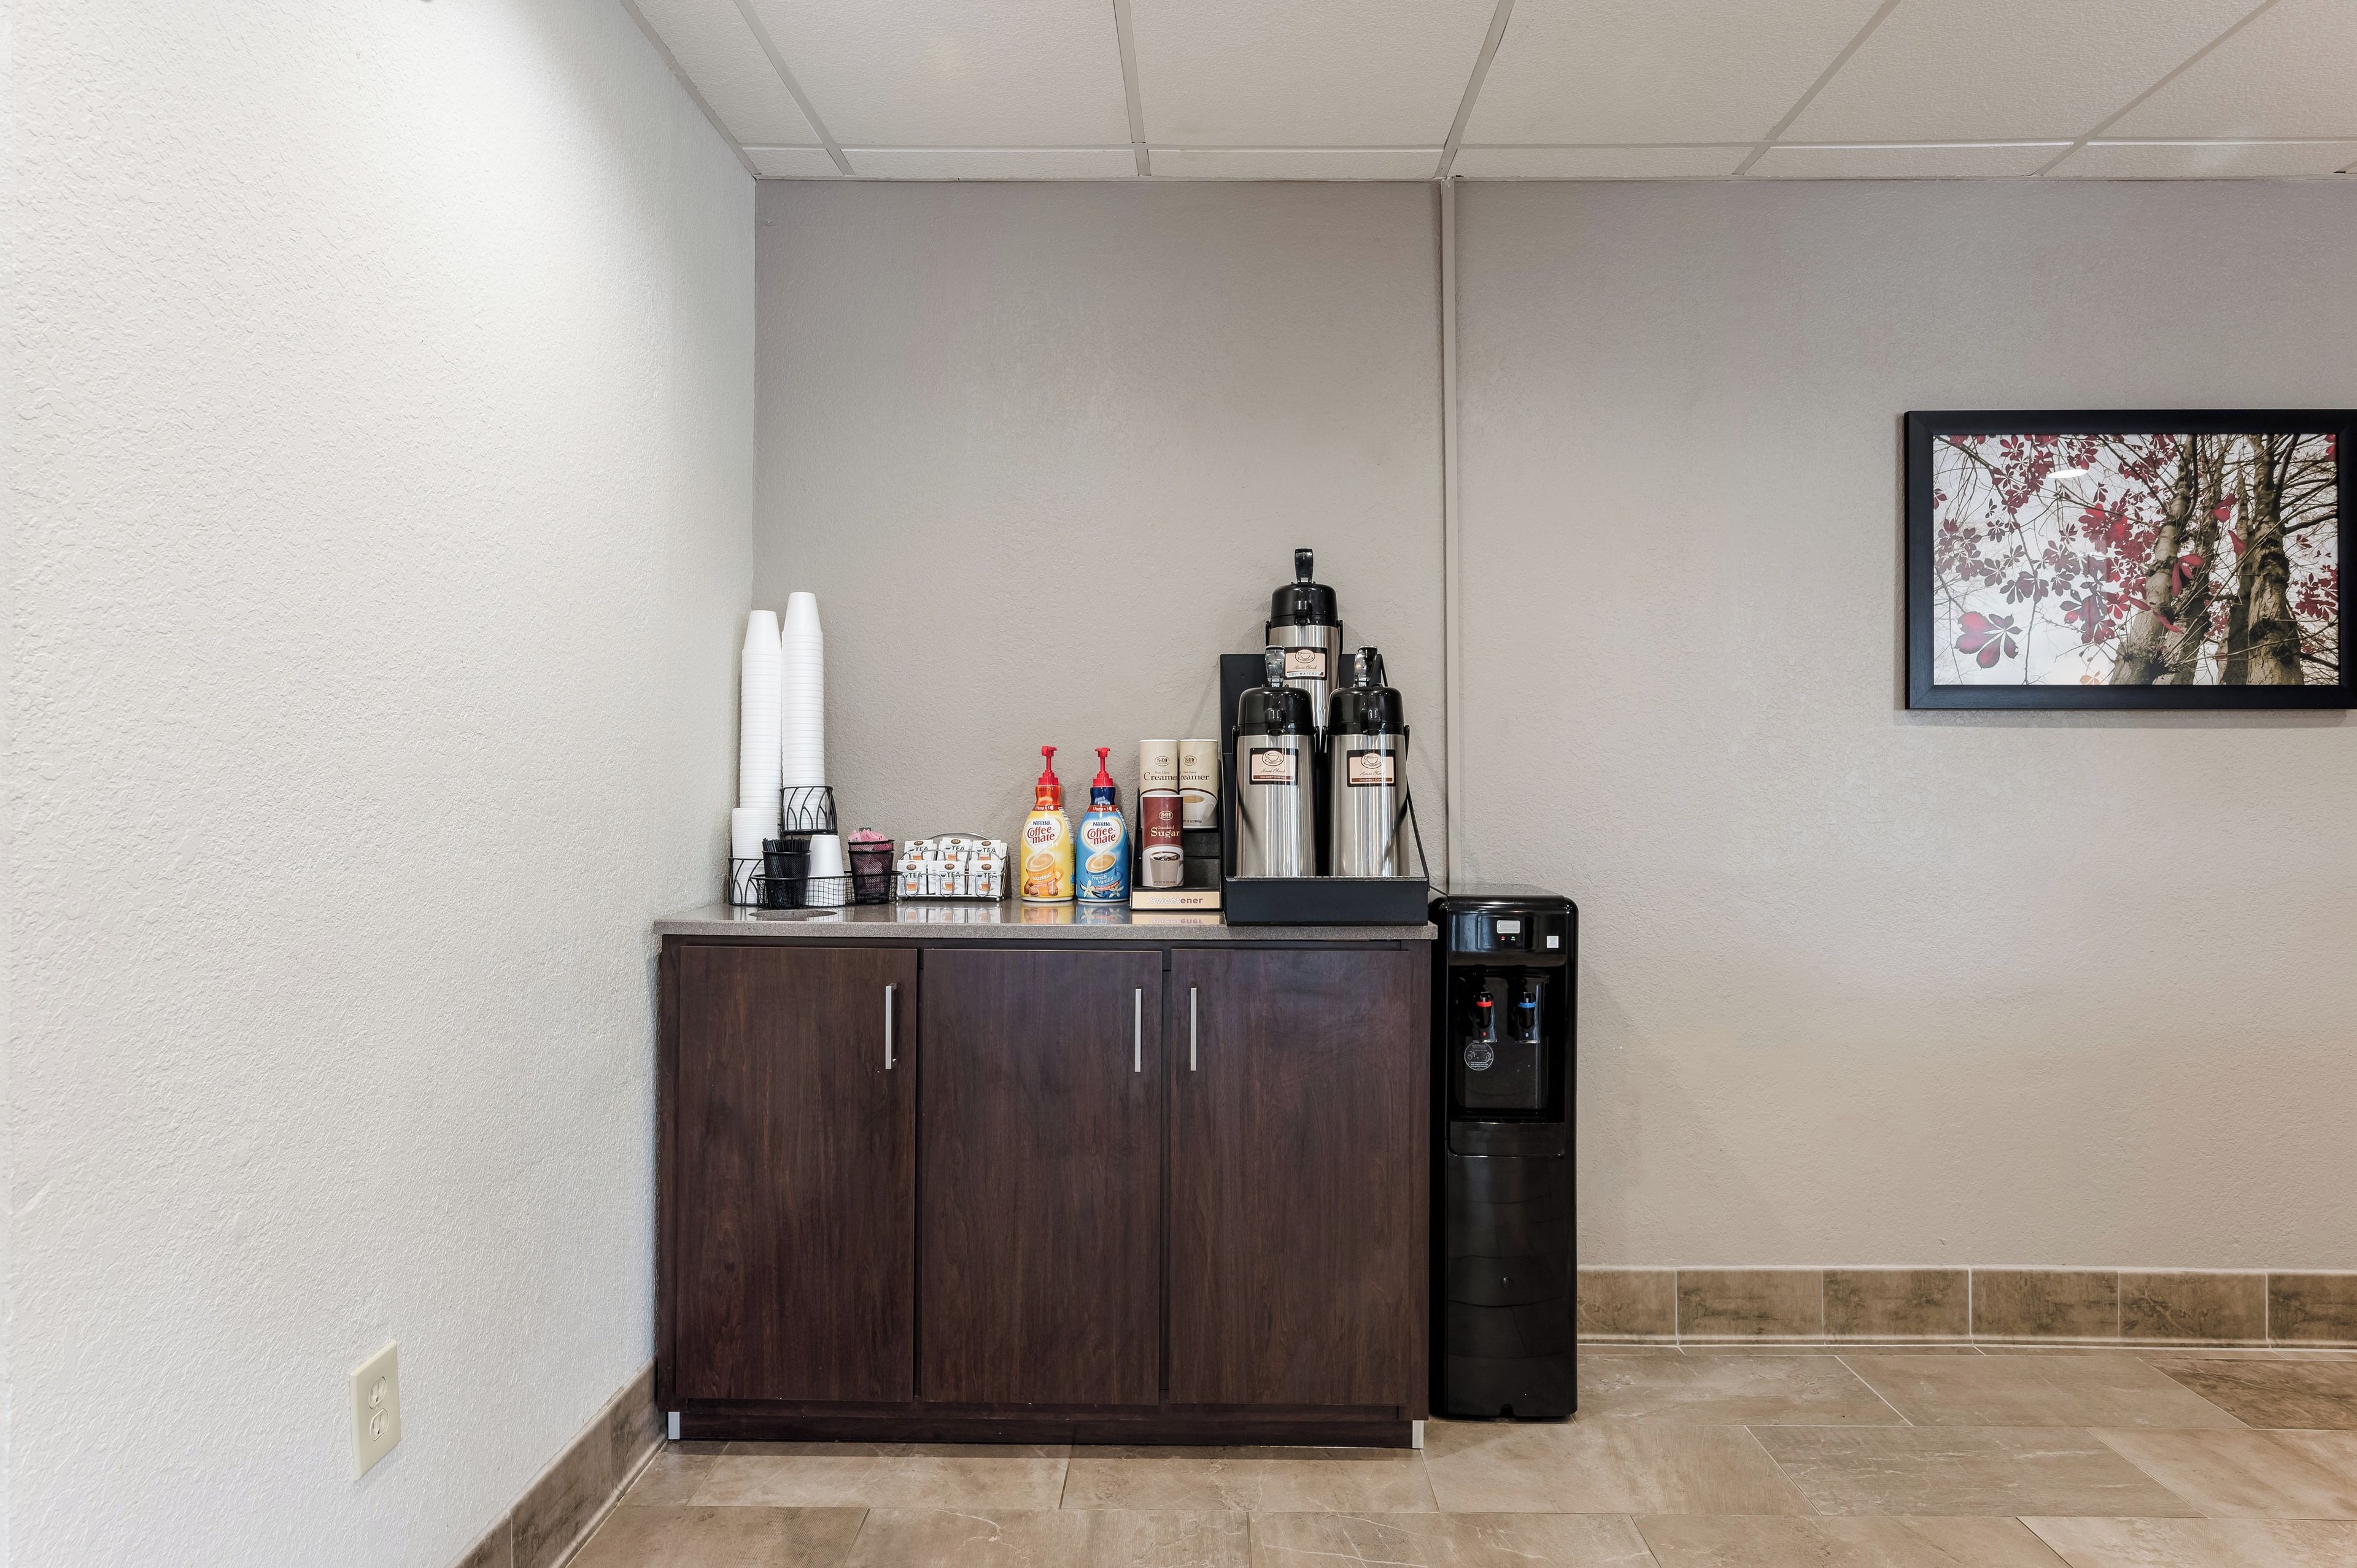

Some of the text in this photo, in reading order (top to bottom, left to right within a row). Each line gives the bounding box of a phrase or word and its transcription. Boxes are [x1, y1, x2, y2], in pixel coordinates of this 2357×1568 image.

[1151, 827, 1180, 838] Sugar
[1032, 833, 1055, 844] mate
[1093, 833, 1116, 845] mate
[1097, 876, 1114, 884] Vanilla
